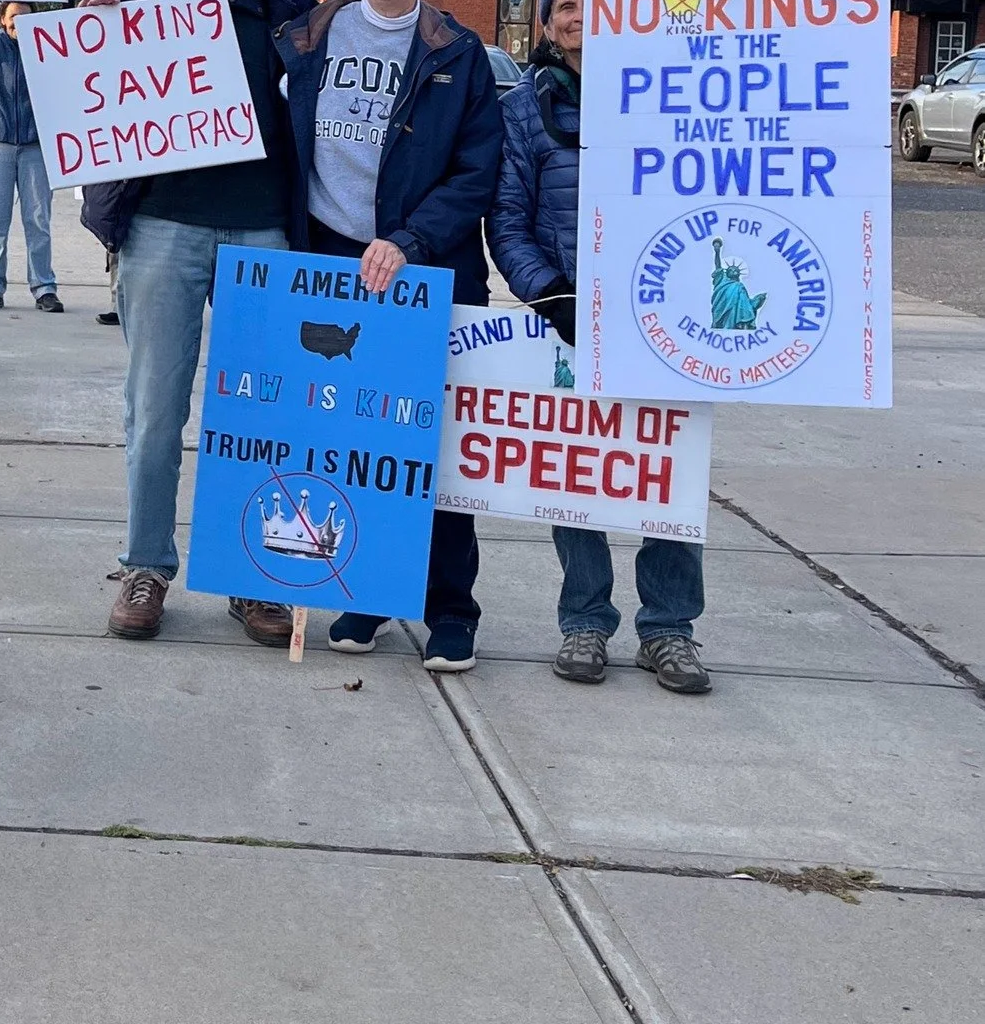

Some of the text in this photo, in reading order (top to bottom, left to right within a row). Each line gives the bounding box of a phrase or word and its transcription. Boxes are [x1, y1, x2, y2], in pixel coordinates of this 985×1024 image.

[33, 12, 106, 63] NO
[666, 23, 703, 36] KINGS
[671, 9, 695, 25] NO
[687, 33, 781, 61] WE THE
[83, 55, 213, 114] SAVE
[318, 55, 404, 96] CON
[620, 61, 849, 115] PEOPLE
[56, 102, 255, 176] DEMOCRACY
[314, 119, 364, 142] CHOOL
[674, 116, 790, 143] HAVE THE
[632, 146, 837, 198] POWER
[235, 260, 269, 288] IN
[638, 210, 826, 332] STAND UP FOR AMERICA
[592, 206, 603, 392] LOVE COMPASSION
[862, 210, 873, 401] EMPATHY KINDNESS
[448, 316, 513, 356] STAND
[641, 312, 811, 385] EVERY BEING MATTERS
[677, 314, 778, 353] DEMOCRACY
[217, 370, 435, 429] LAW IS KING
[444, 383, 690, 446] REEDOM OF
[204, 429, 433, 500] TRUMP IS NOT!
[459, 432, 673, 505] SPEECH
[434, 491, 702, 538] PASSION EMPATHY KINDNESS
